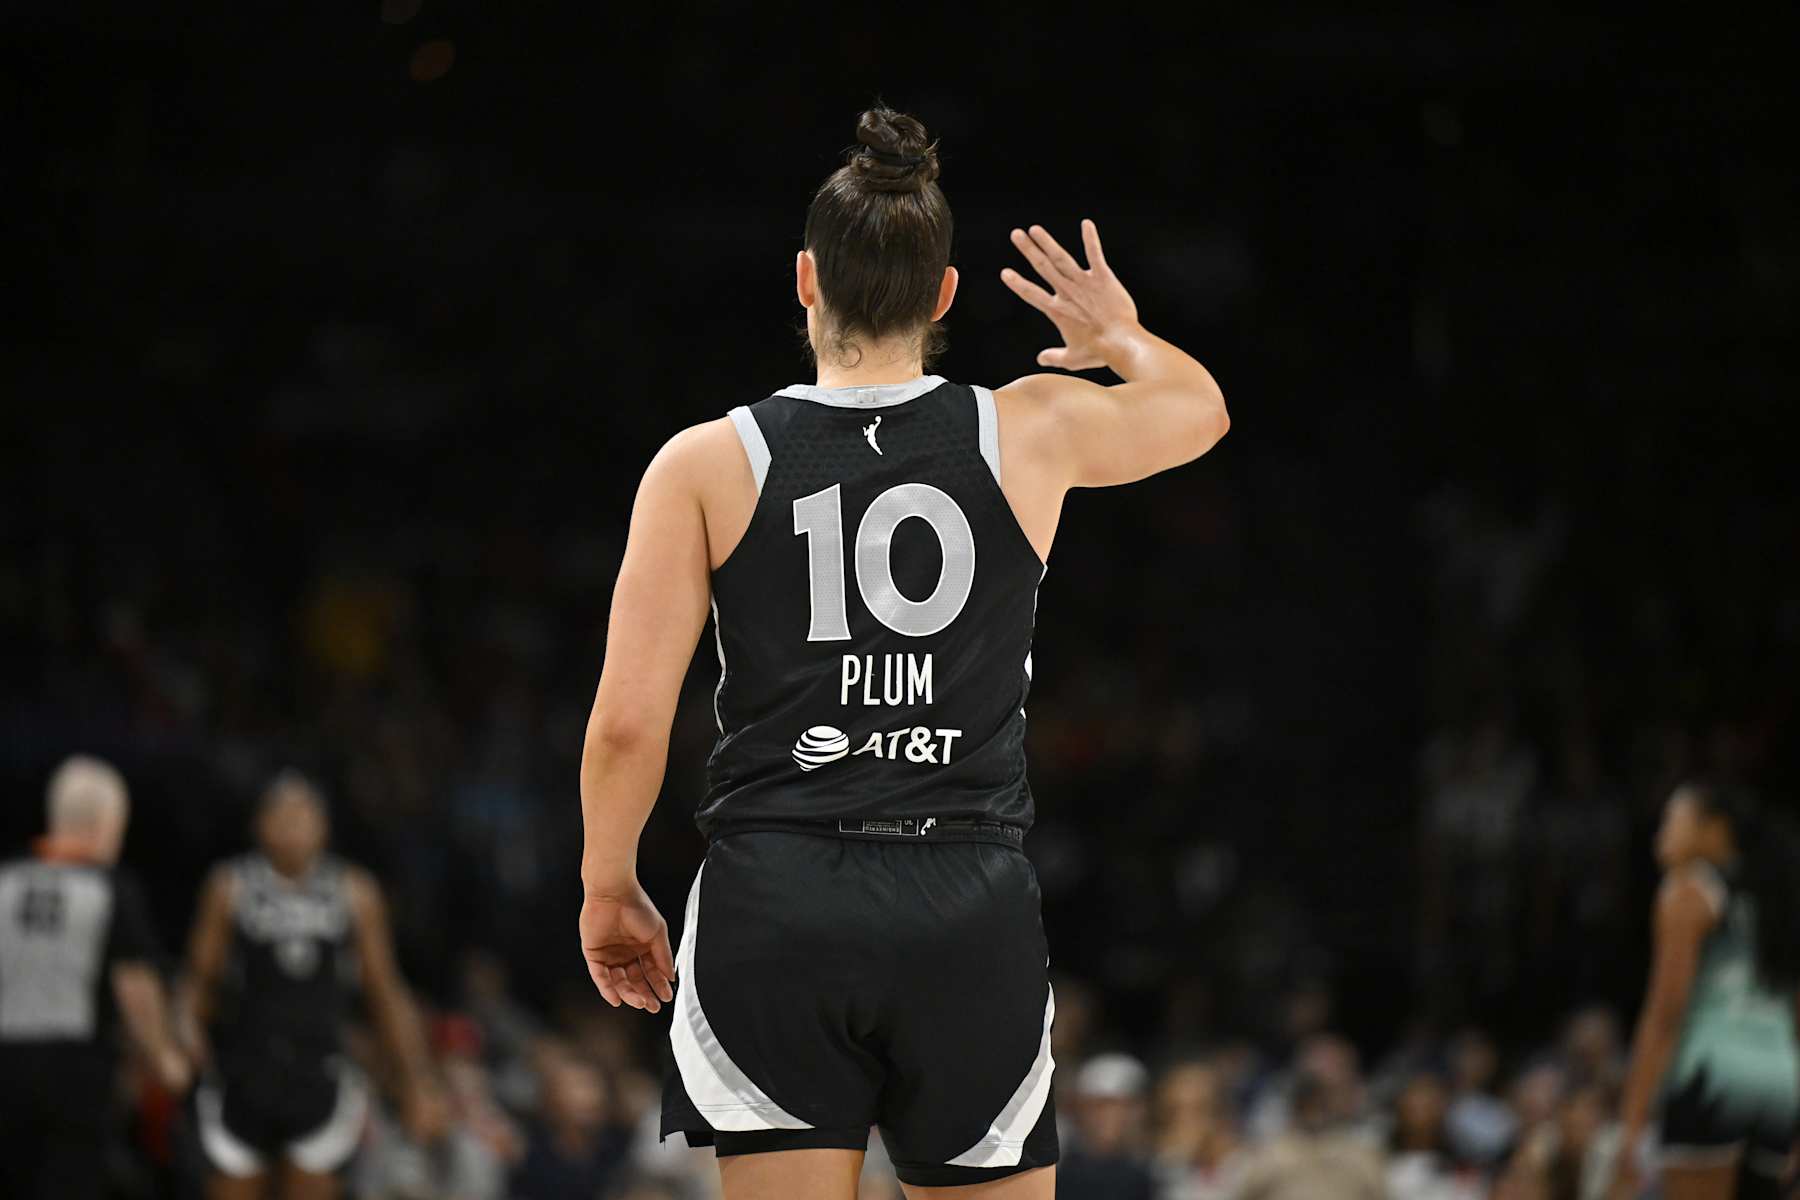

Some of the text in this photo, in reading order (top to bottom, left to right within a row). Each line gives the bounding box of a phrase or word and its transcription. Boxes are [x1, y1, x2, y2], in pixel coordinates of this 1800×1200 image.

[792, 482, 976, 642] 10
[840, 653, 933, 706] PLUM
[851, 726, 963, 765] AT&T
